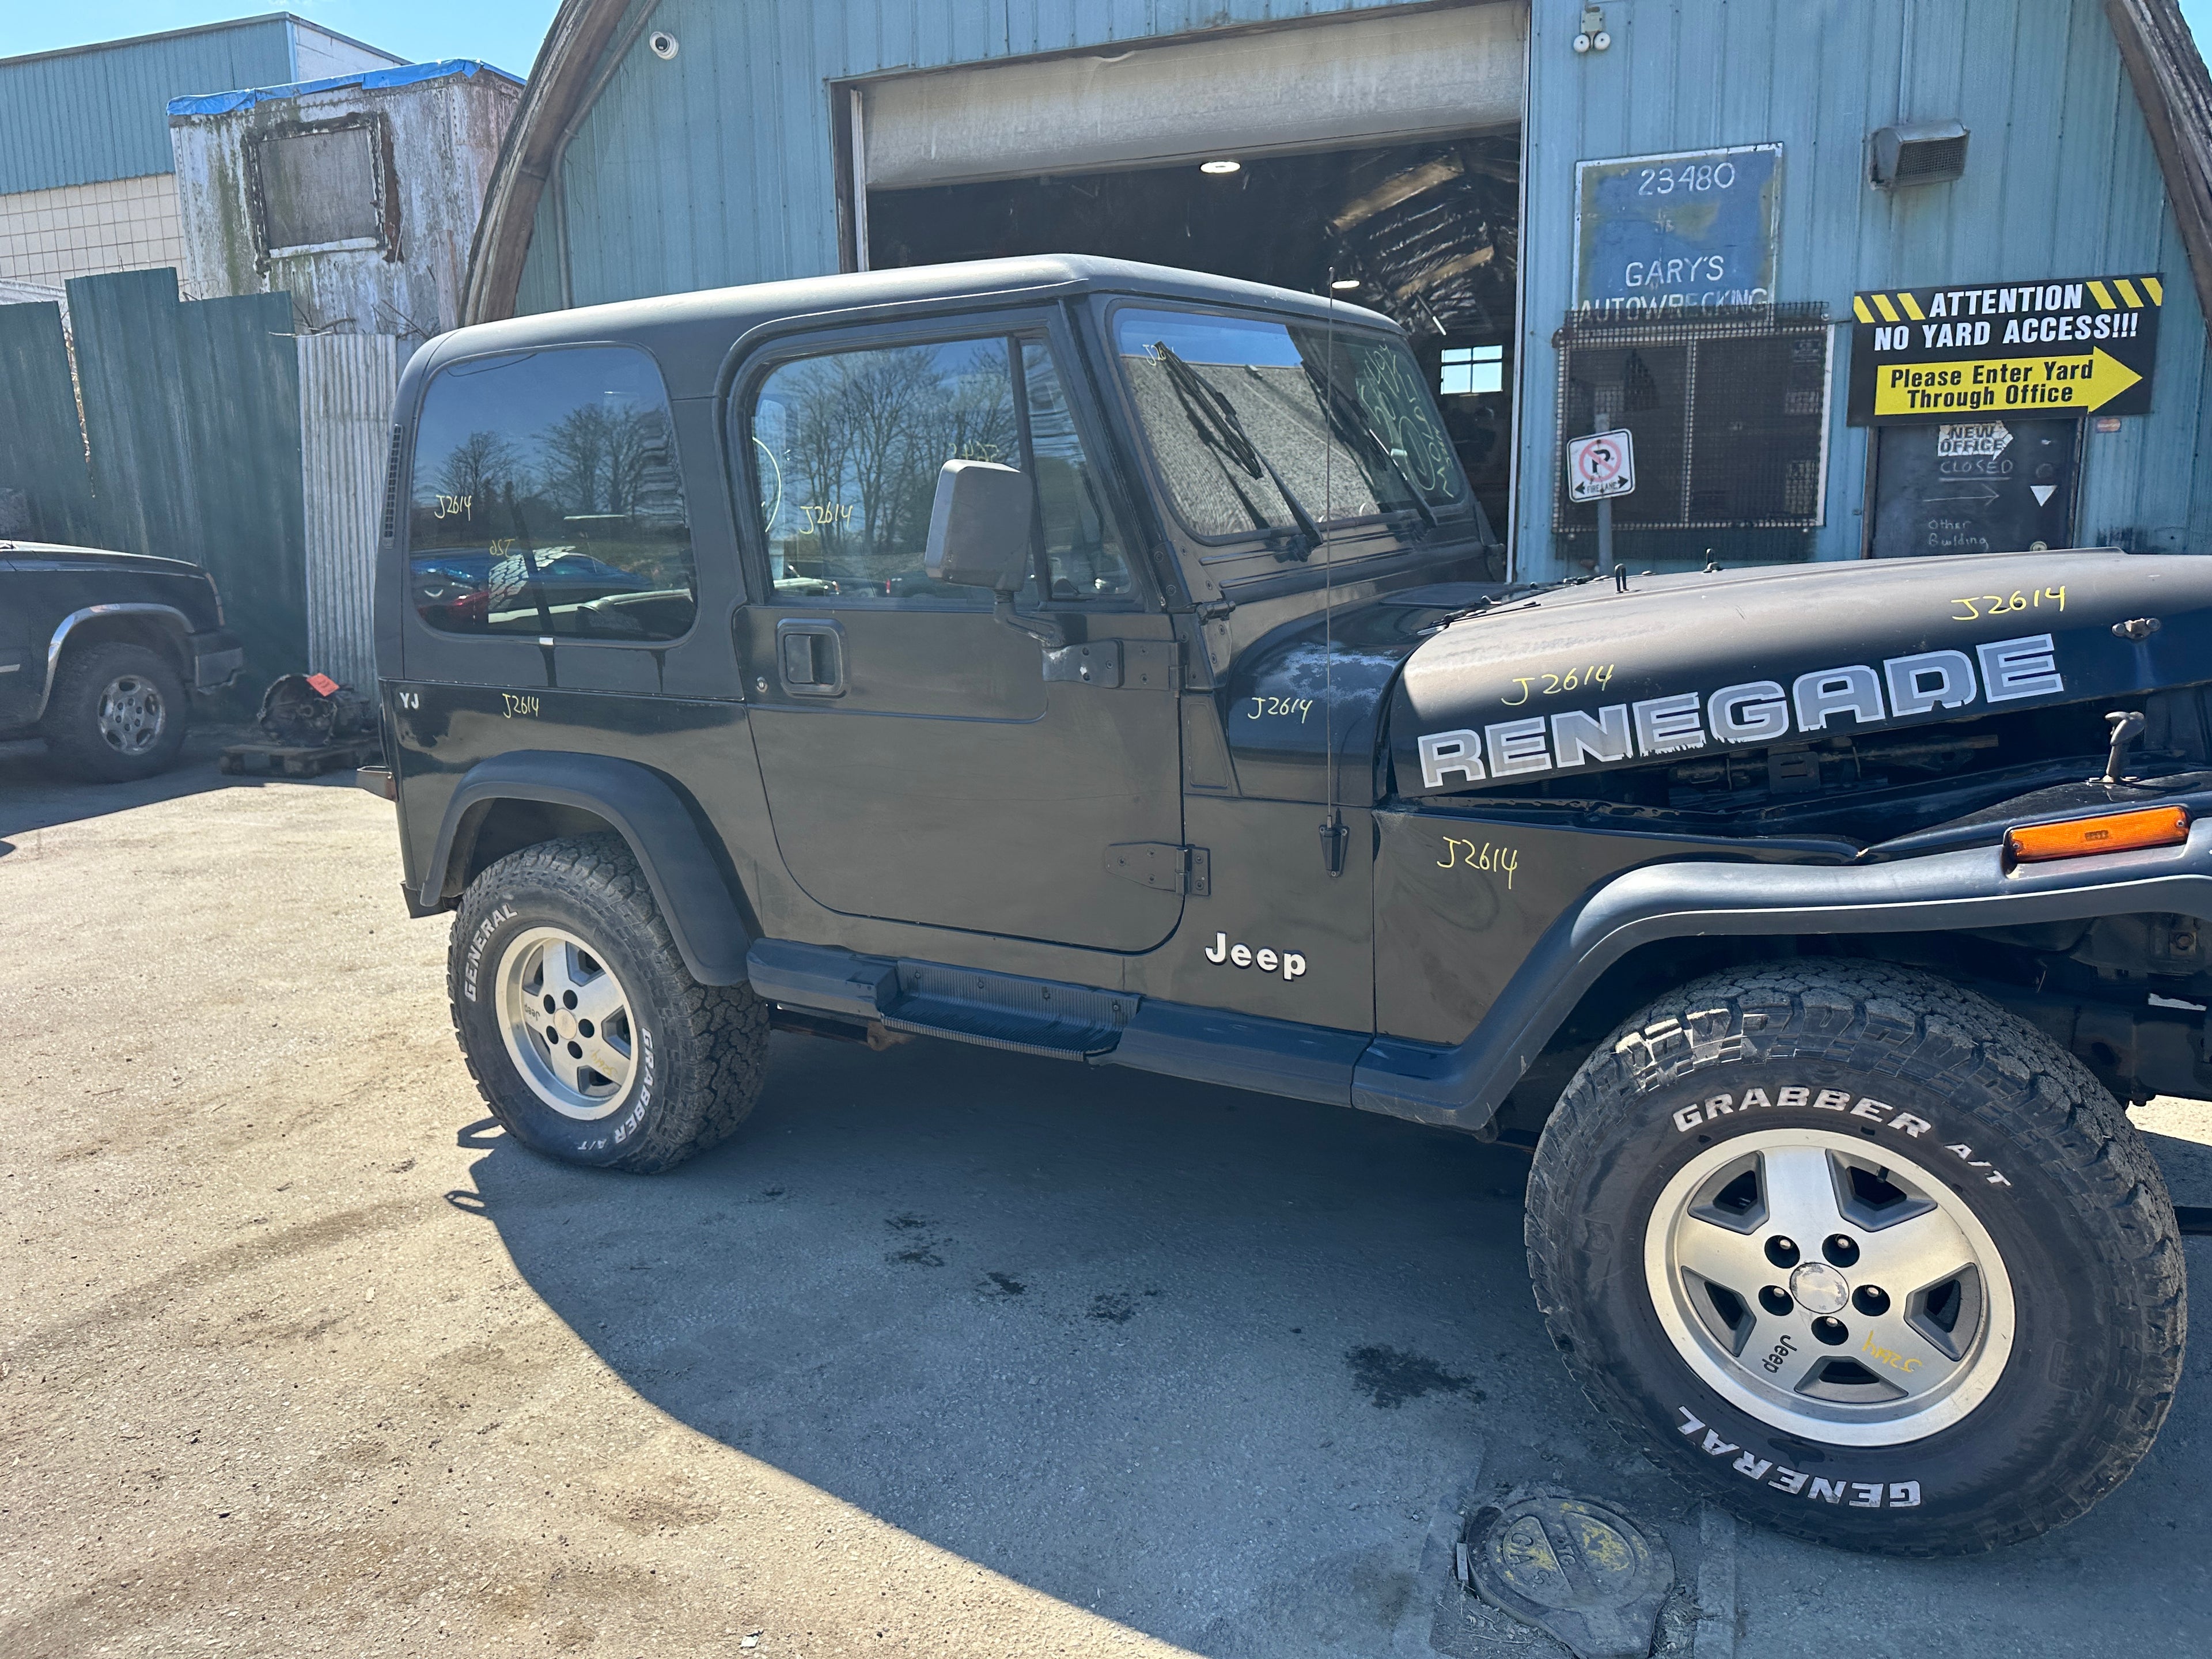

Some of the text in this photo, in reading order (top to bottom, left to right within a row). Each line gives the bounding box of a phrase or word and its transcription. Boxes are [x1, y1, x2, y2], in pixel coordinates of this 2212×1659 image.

[1638, 162, 1736, 196] 23480
[1625, 255, 1725, 287] GARY'S
[1929, 284, 2083, 318] ATTENTION
[1874, 312, 2139, 351] NO YARD ACCESS!!!
[1890, 359, 2094, 389] Please Enter Yard
[1907, 384, 2073, 410] Through Office
[1940, 438, 2005, 453] OFFICE
[1949, 424, 1995, 440] NEW
[1940, 459, 2013, 474] CLOSED
[1586, 482, 1618, 493] FIRE LANE
[434, 494, 472, 521] J2614
[799, 501, 853, 535] J2614
[1951, 586, 2066, 620] J2614
[399, 692, 419, 710] YJ
[1501, 664, 1615, 706] J2614
[502, 693, 539, 719] J2614
[1247, 696, 1313, 724] J2614
[1417, 633, 2065, 789] RENEGADE
[1437, 836, 1518, 890] J2614
[464, 903, 518, 1002] GENERAL
[1205, 930, 1307, 982] Jeep
[524, 1003, 540, 1021] Jeep
[577, 1027, 655, 1150] GRABBER A/T
[1672, 1086, 2012, 1187] GRABBER A/T
[1762, 1334, 1798, 1373] Jeep
[1677, 1405, 1922, 1508] GENERAL
